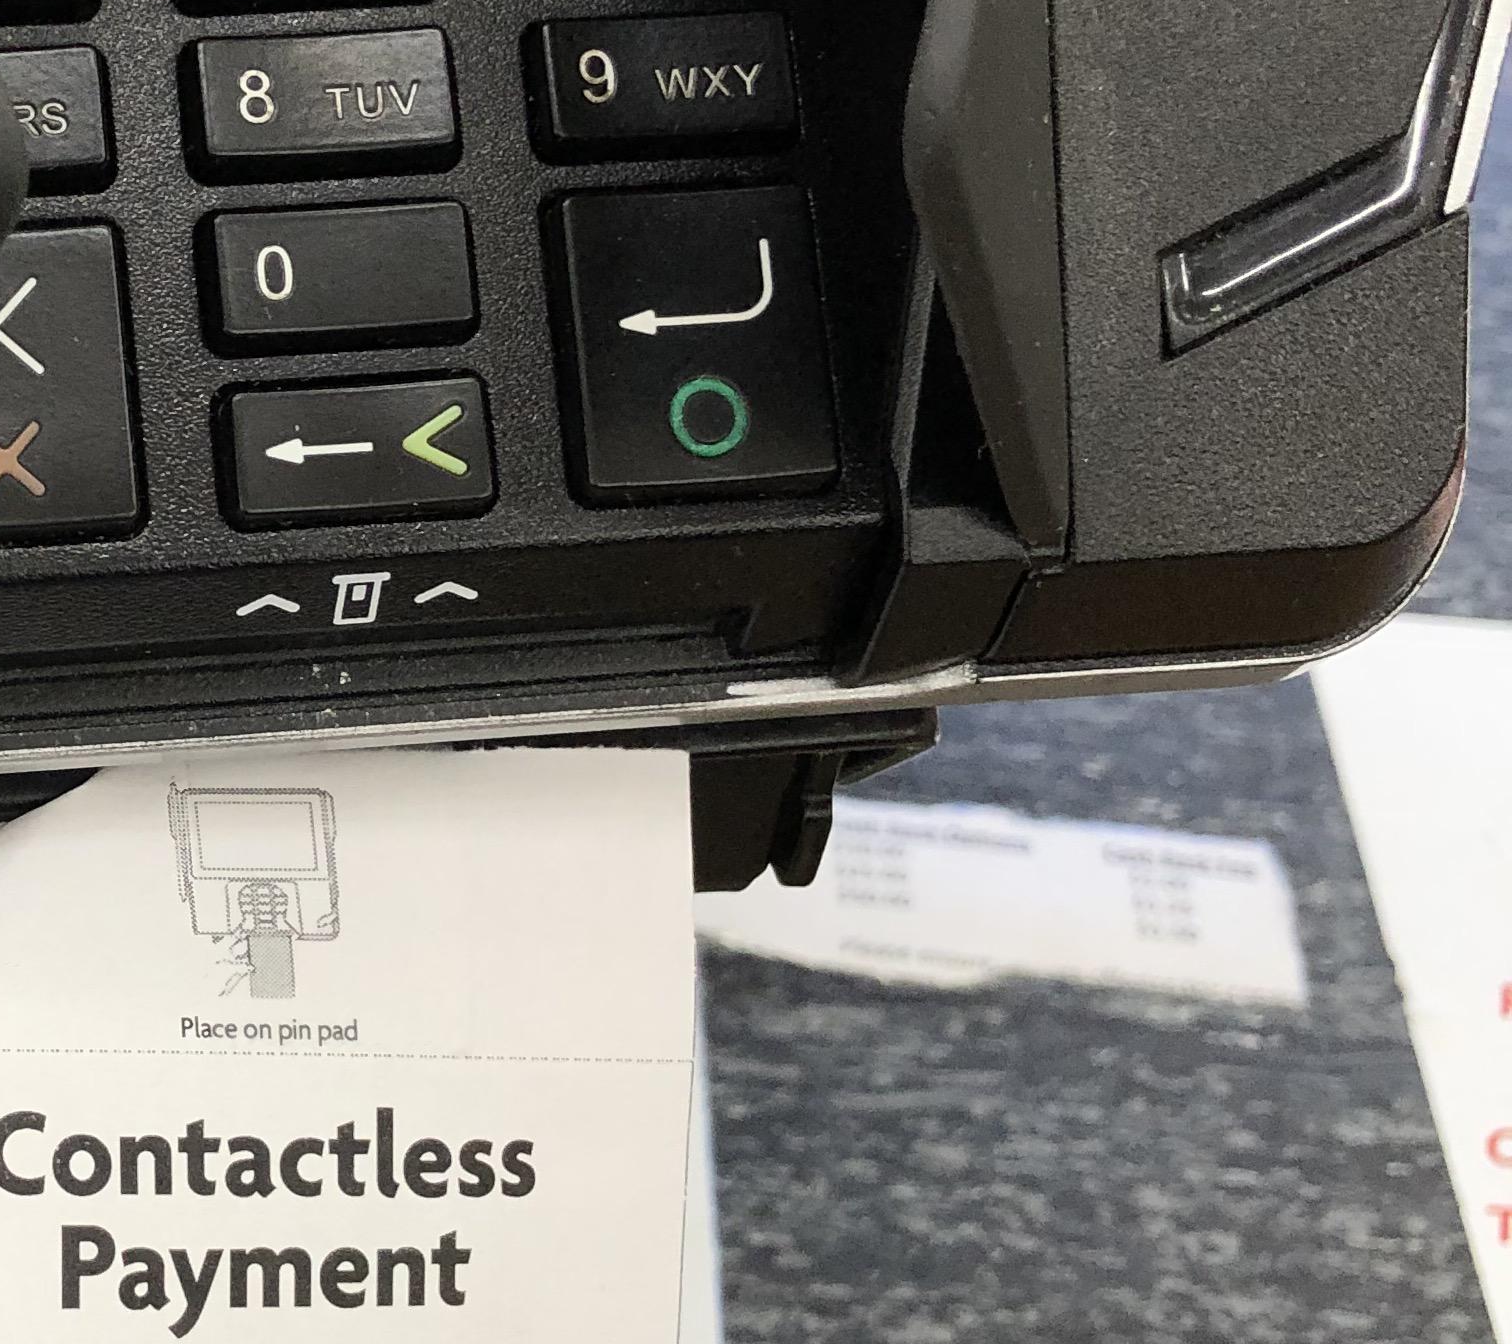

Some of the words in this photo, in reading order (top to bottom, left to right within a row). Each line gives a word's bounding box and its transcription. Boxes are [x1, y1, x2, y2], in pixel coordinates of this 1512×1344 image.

[238, 69, 277, 124] 8
[326, 82, 421, 122] TUV
[578, 49, 616, 104] 9
[656, 64, 762, 103] WXY
[12, 101, 69, 137] RS
[255, 244, 294, 301] 0
[181, 1016, 237, 1038] Place
[244, 1024, 271, 1039] on
[279, 1019, 311, 1045] pin
[318, 1019, 357, 1046] pad
[62, 1226, 471, 1338] Payment
